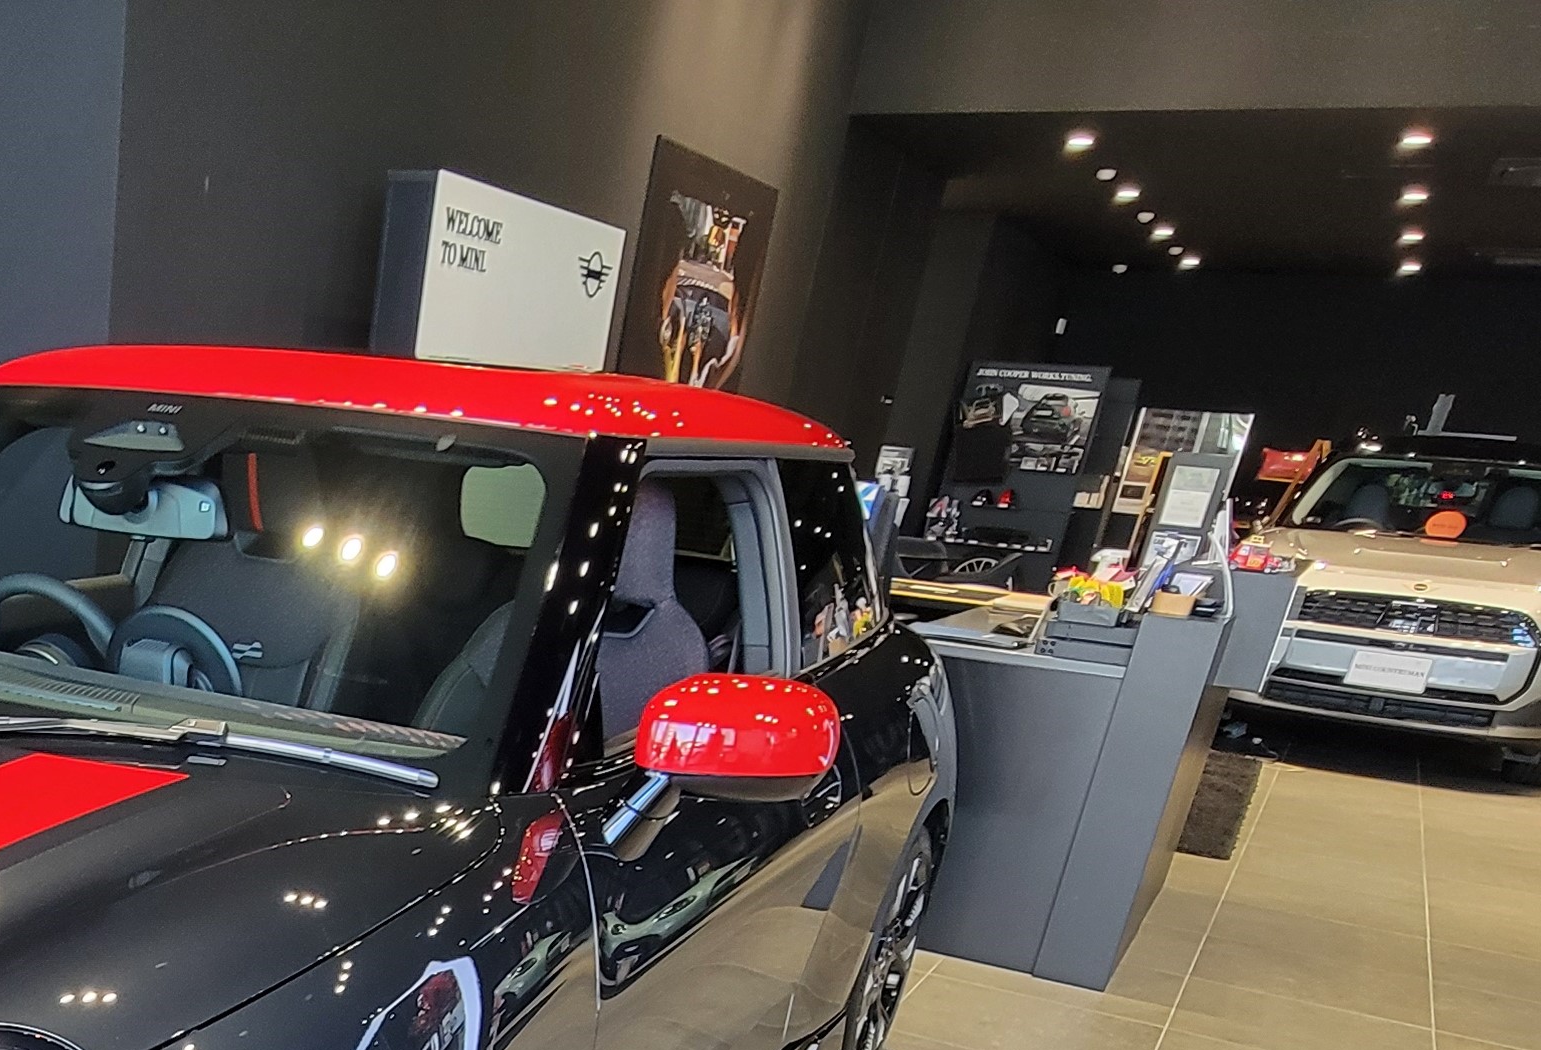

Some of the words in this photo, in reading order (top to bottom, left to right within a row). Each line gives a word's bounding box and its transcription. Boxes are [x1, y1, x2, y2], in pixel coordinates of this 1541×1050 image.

[446, 206, 503, 245] WELCOME
[441, 240, 457, 265] TO
[999, 369, 1030, 379] COOPER
[147, 403, 183, 414] MINI
